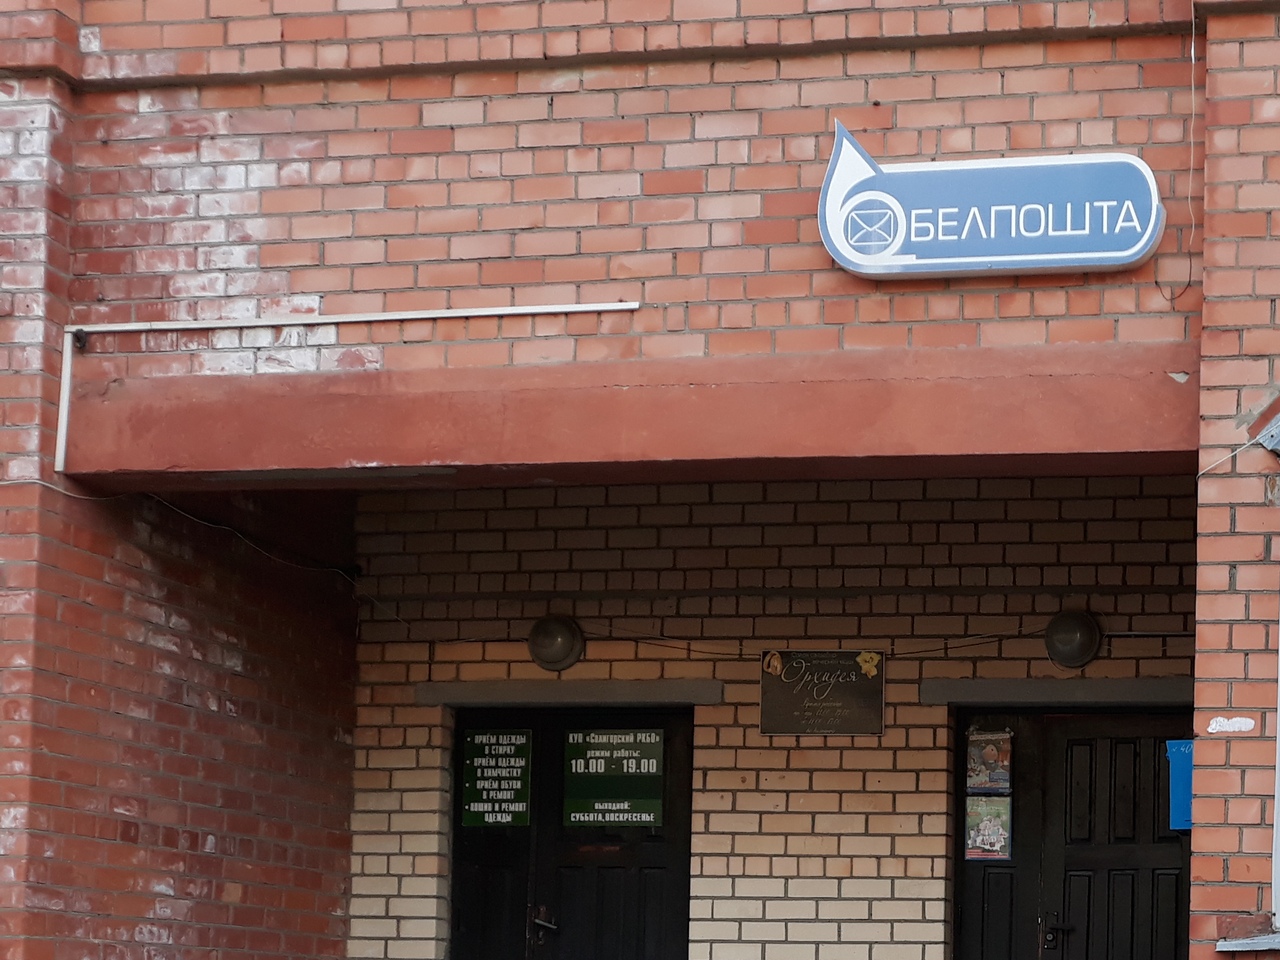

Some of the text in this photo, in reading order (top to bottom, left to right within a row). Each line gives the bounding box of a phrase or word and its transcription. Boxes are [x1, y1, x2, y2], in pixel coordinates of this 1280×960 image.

[910, 200, 1142, 241] БЕЛПОШТА
[780, 659, 860, 700] Орхидея
[474, 733, 527, 745] ПРИЁМ ОДЕЖДЫ
[568, 733, 583, 744] КУП
[484, 746, 516, 755] В СТИРКУ
[586, 748, 641, 759] режим работы:
[473, 756, 526, 768] ПРИЁМ ОДЕЖДЫ
[570, 758, 605, 773] 10.00
[622, 758, 657, 773] 19.00
[483, 768, 522, 778] ХИМЧИСТКУ
[476, 779, 522, 790] ПРИЁМ ОБУВИ
[482, 791, 515, 800] В РЕМОНТ
[470, 802, 527, 812] ПОШИВ И РЕМОНТ
[484, 812, 512, 823] ОДЕЖДЫ
